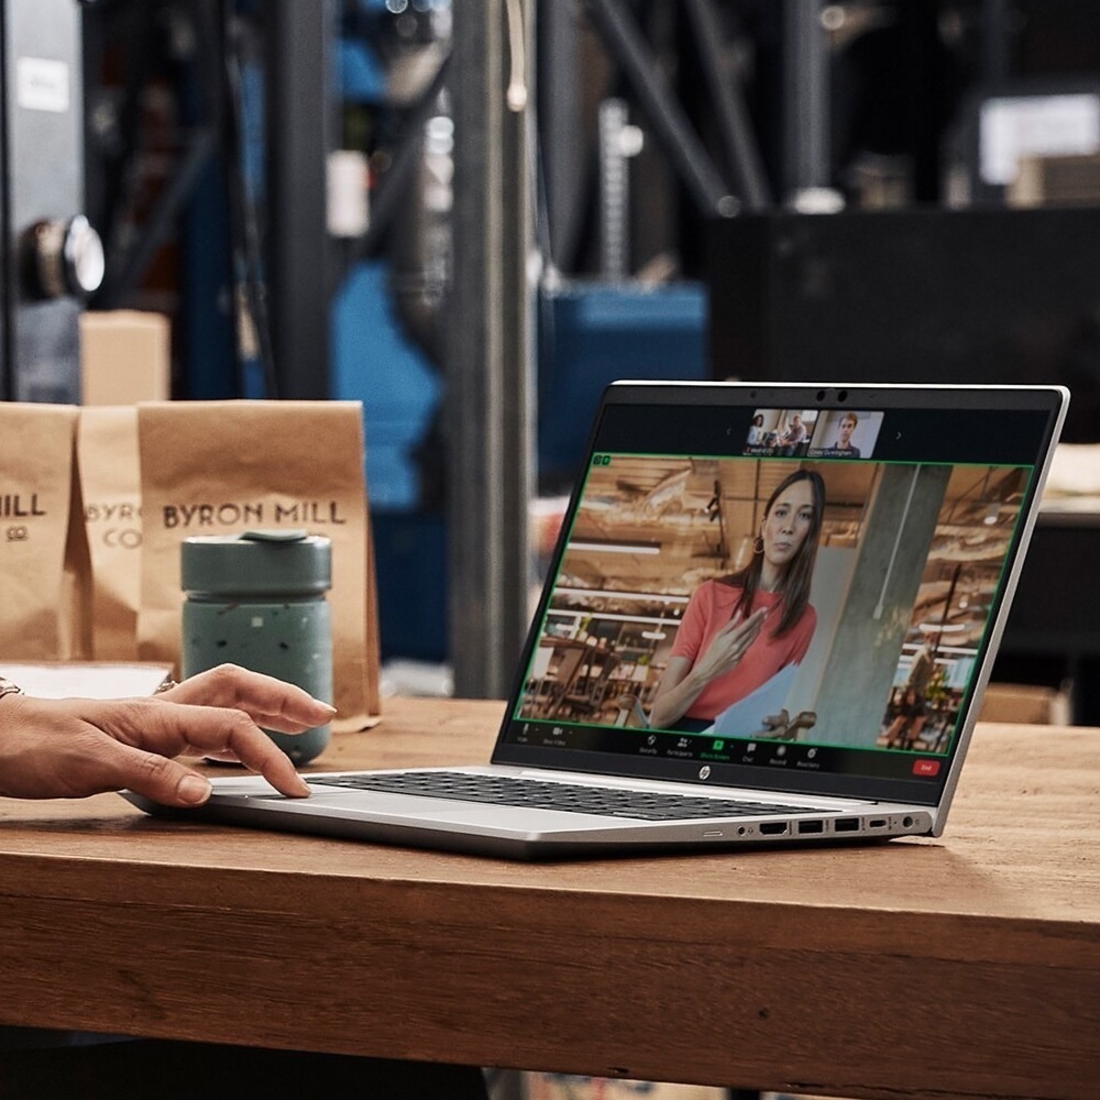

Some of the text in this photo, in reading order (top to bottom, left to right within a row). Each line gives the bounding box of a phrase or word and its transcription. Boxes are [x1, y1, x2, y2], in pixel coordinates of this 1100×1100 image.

[87, 504, 142, 522] BYR
[163, 501, 347, 529] BYRON MILL
